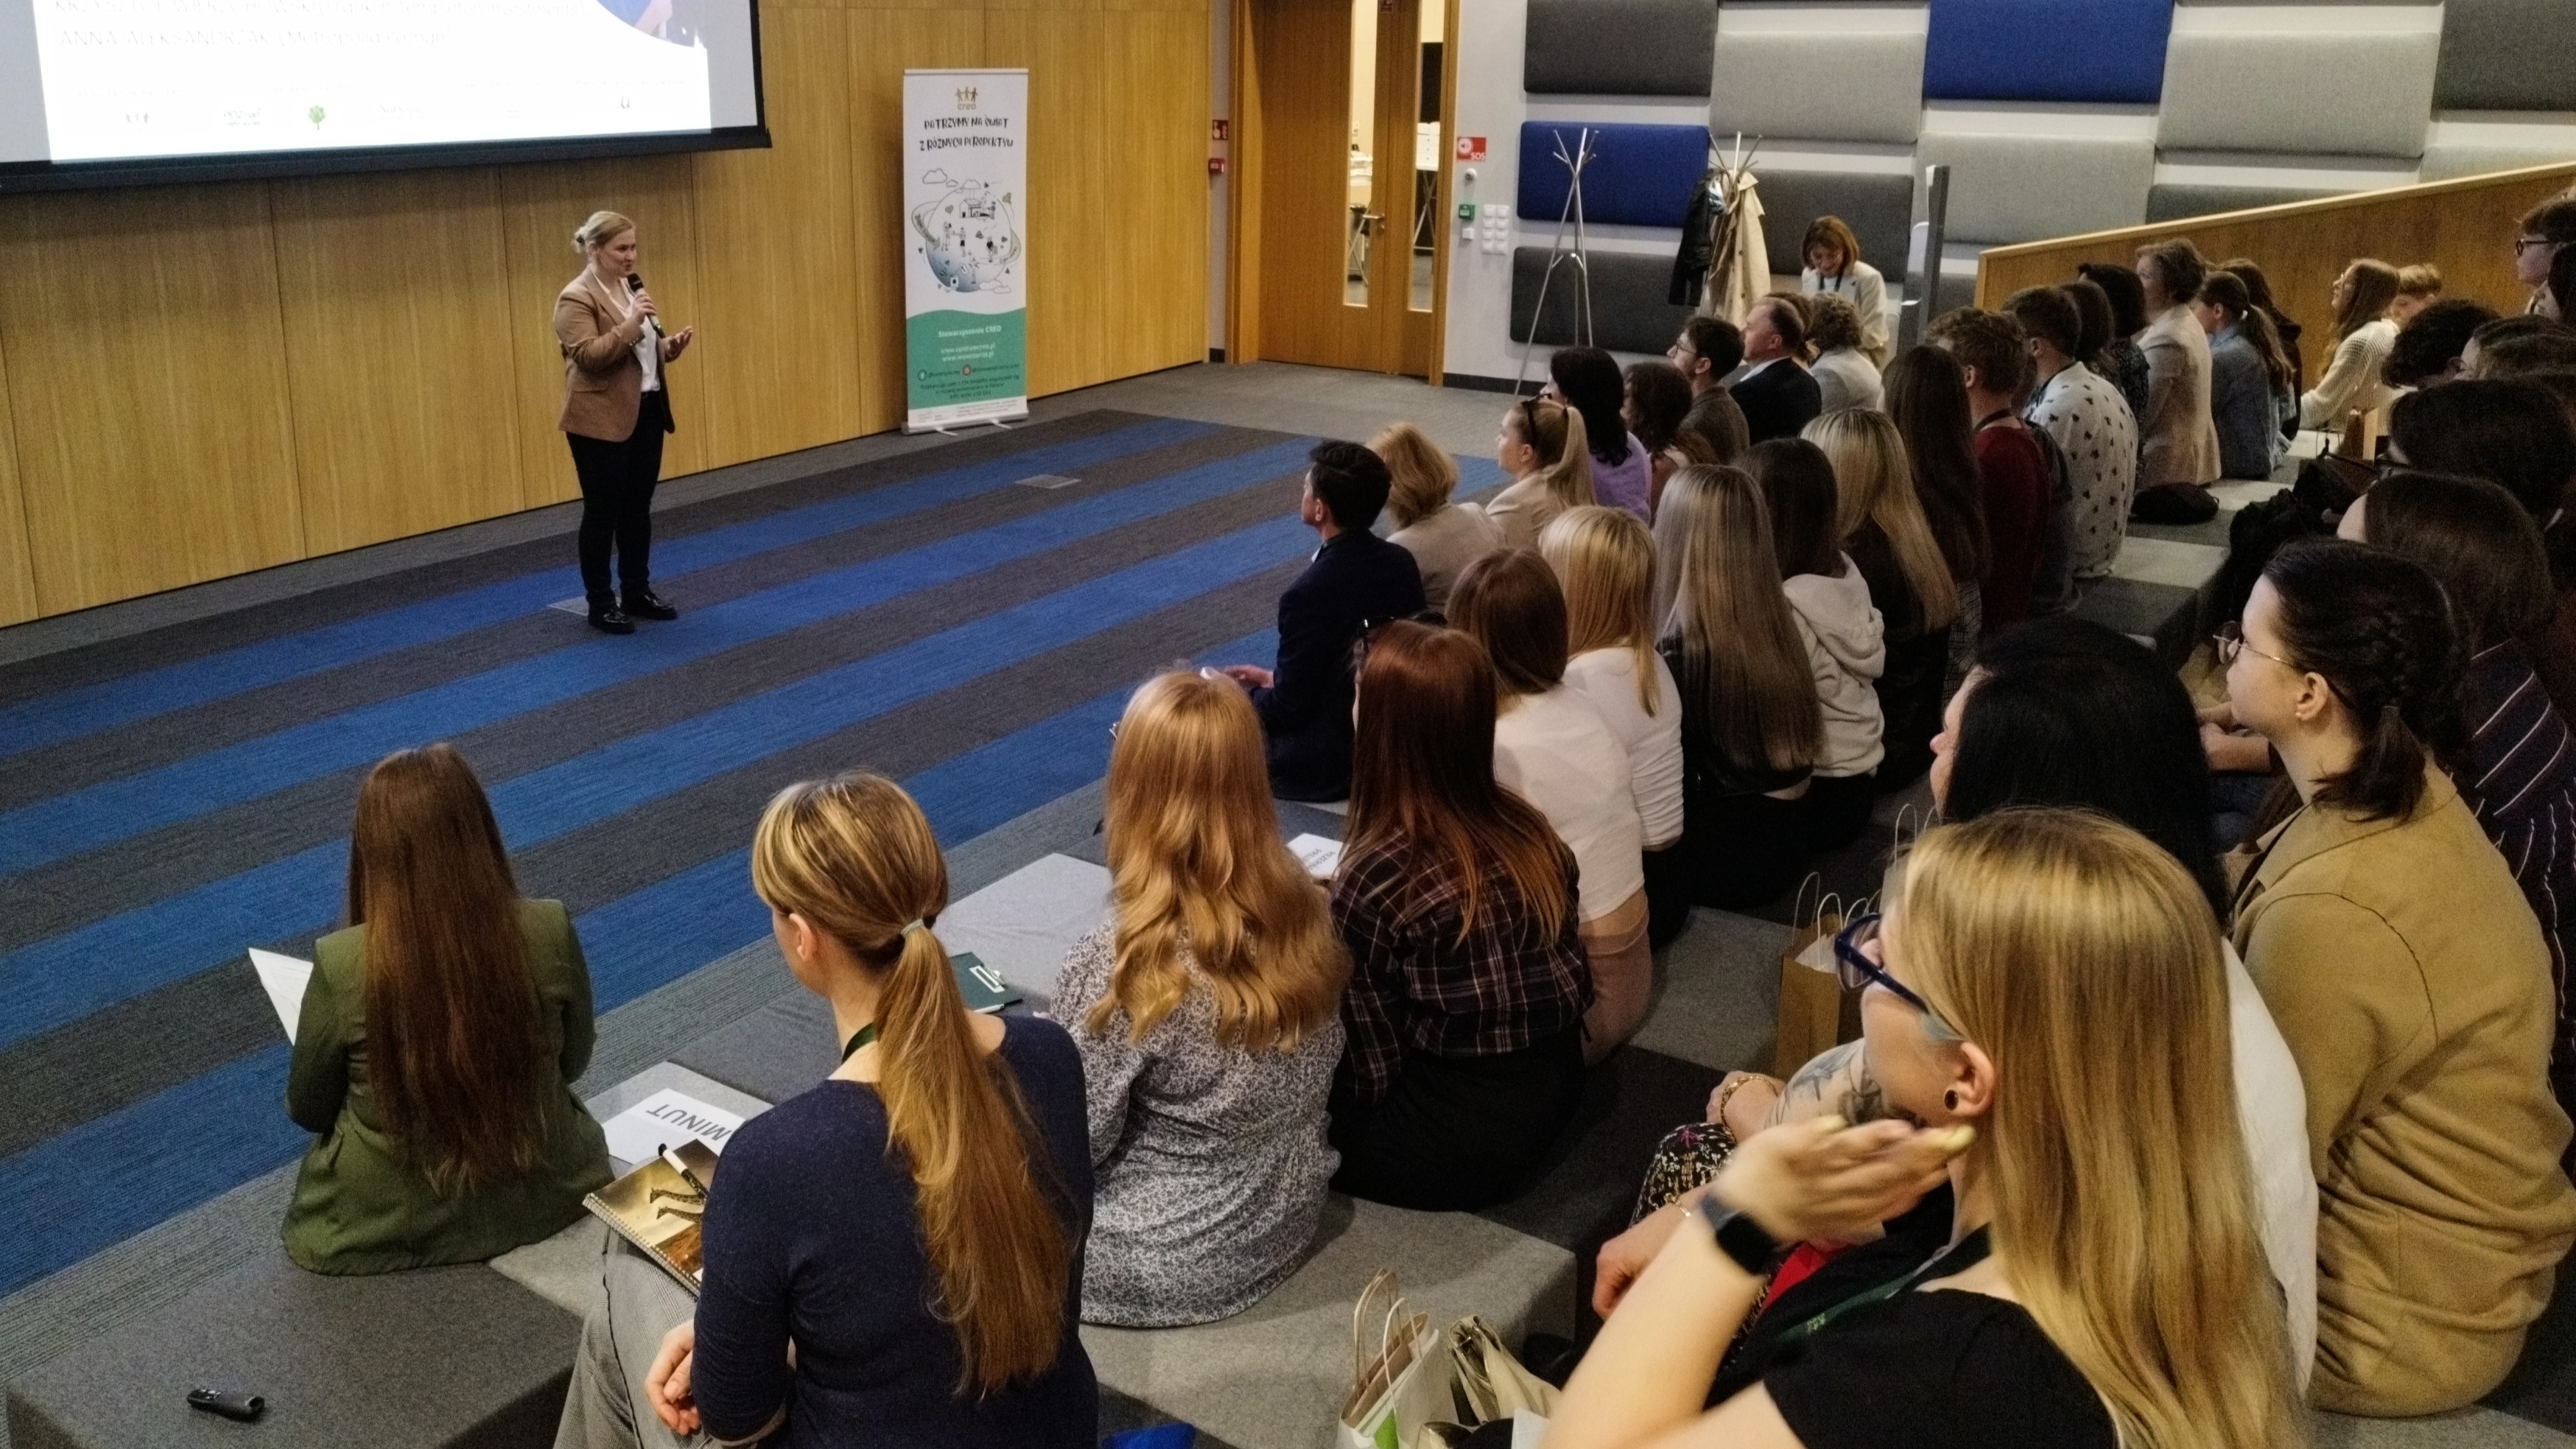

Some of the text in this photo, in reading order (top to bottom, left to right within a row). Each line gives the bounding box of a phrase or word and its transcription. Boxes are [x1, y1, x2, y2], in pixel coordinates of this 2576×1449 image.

[61, 31, 116, 46] ANNA
[924, 113, 1008, 130] PATRZYMY NA ŚWIAT
[919, 140, 925, 151] Z
[985, 325, 1002, 333] CREO
[646, 1104, 732, 1140] MINUT
